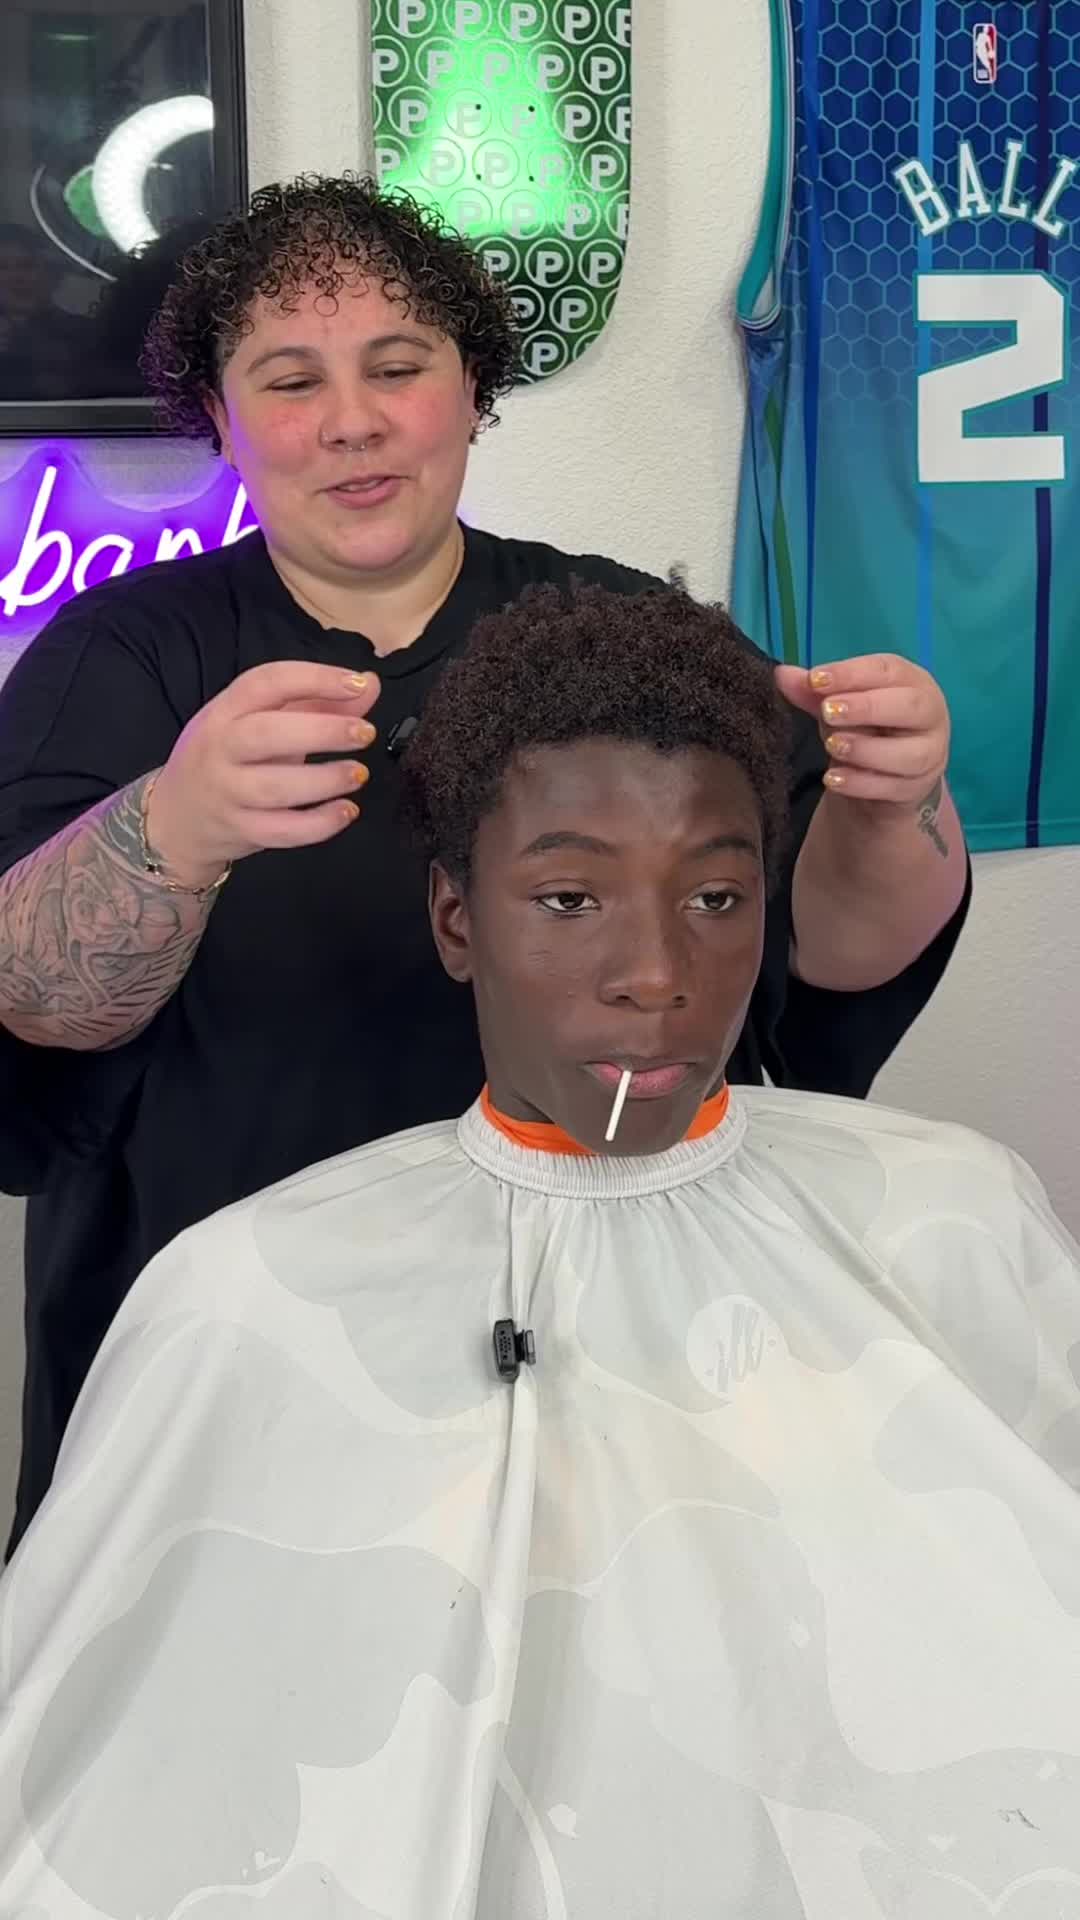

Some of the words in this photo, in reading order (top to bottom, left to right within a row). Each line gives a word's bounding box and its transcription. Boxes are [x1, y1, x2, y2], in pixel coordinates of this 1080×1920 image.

[399, 0, 427, 36] P
[455, 0, 482, 39] P
[510, 2, 537, 41] P
[563, 5, 591, 43] P
[373, 48, 400, 86] P
[427, 50, 455, 88] P
[538, 54, 565, 92] P
[590, 56, 617, 94] P
[400, 99, 428, 137] P
[564, 104, 591, 142] P
[376, 148, 400, 187] P
[540, 154, 565, 191] P
[591, 154, 617, 191] P
[893, 139, 1076, 237] BALL
[511, 203, 537, 239] P
[563, 203, 592, 240] P
[536, 251, 564, 286] P
[588, 252, 617, 287] P
[560, 298, 588, 332] P
[531, 342, 559, 375] P
[917, 273, 1065, 483] 2
